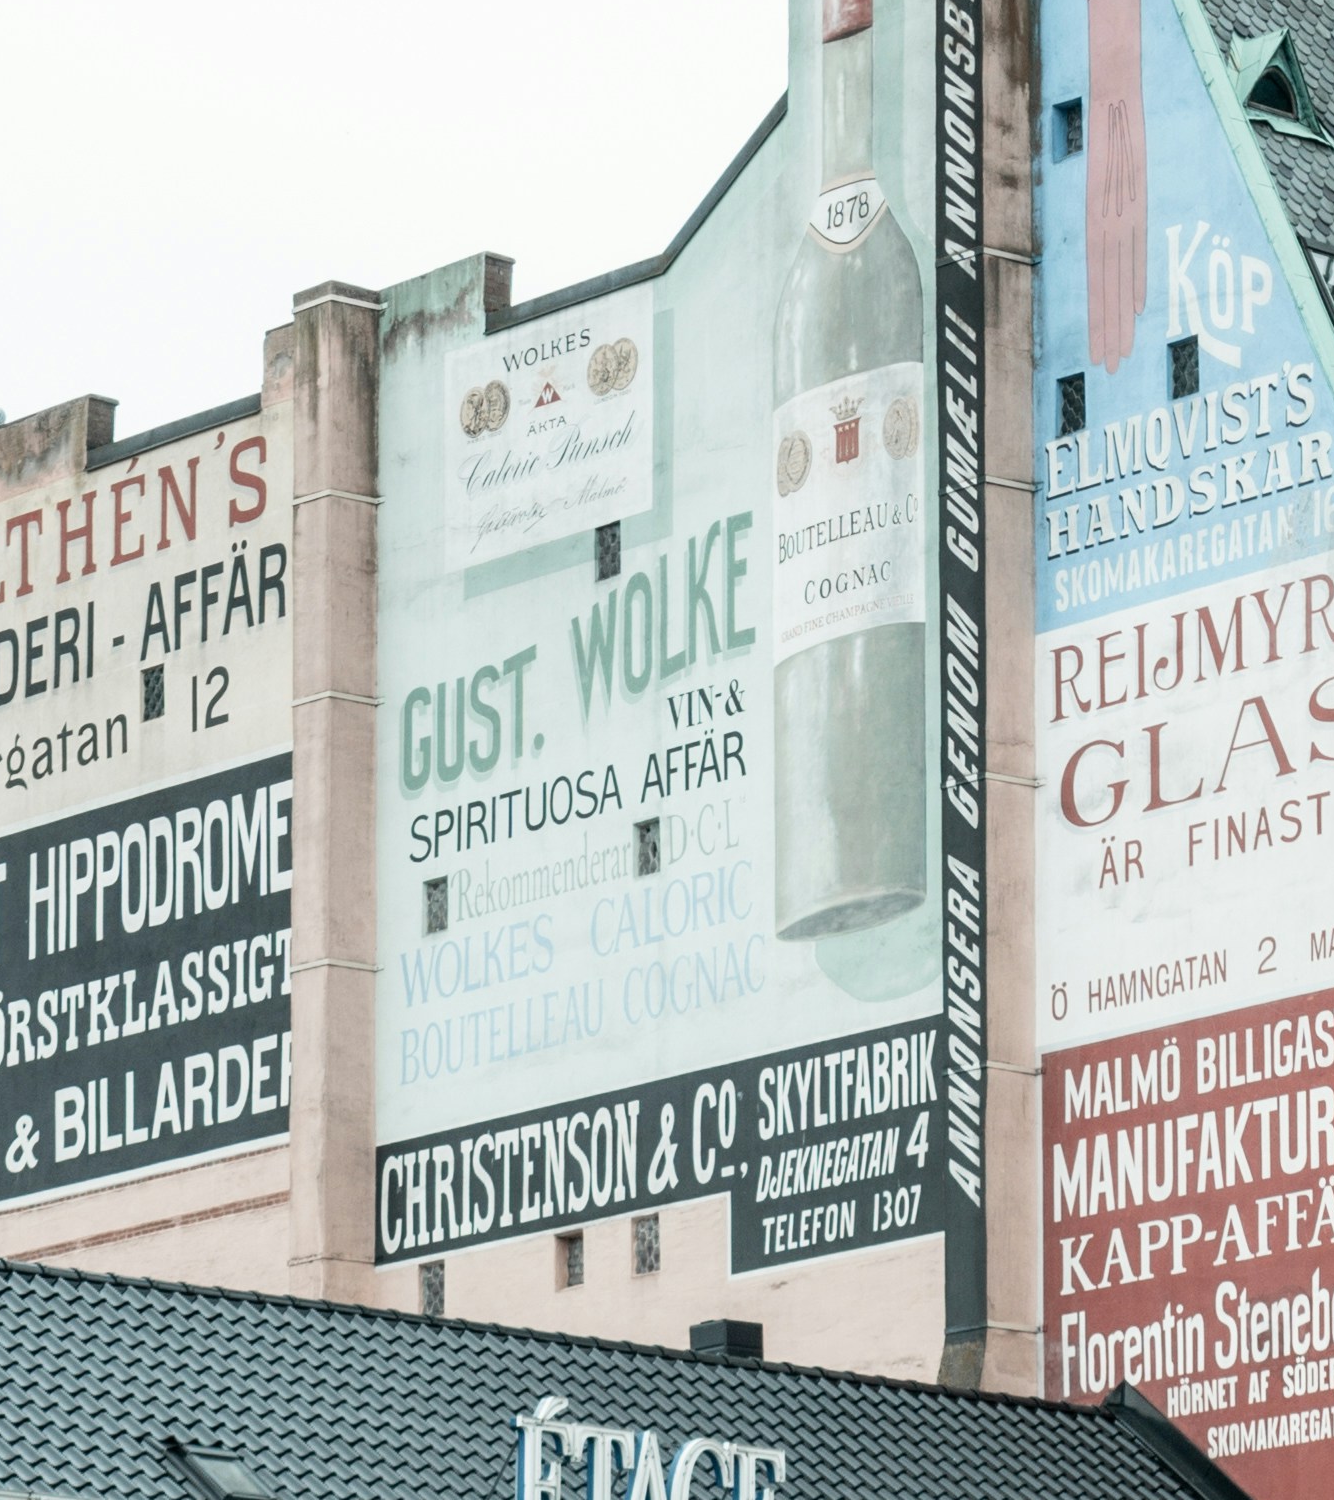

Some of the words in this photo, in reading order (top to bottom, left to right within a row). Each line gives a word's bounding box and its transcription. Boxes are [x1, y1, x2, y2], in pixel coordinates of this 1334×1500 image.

[825, 190, 870, 231] 1878
[1164, 219, 1274, 368] KÖP
[502, 328, 591, 373] WOLKES
[527, 414, 567, 436] ÄKTA
[1045, 360, 1316, 501] ELMQVIST'S
[778, 501, 889, 565] BOUTELLEAU
[892, 504, 903, 525] &
[1045, 430, 1334, 561] HANDSKAR
[141, 540, 287, 662] AFFÄR
[804, 560, 892, 604] COGNAC
[1055, 503, 1297, 613] SKOMAKAREGATAN
[190, 665, 232, 735] 12
[401, 643, 546, 796] GUST.
[569, 510, 757, 726] WOLKE
[945, 592, 980, 830] GENOM
[409, 764, 623, 863] SPIRITUOSA
[641, 729, 747, 803] AFFÄR
[1098, 835, 1145, 891] ÄR
[1187, 789, 1333, 868] FINAST
[28, 779, 293, 960] HIPPODROME
[450, 831, 632, 923] Rekommenderar
[400, 913, 555, 1009] WOLKES
[590, 860, 754, 958] CALORIC
[1051, 982, 1068, 1022] Ö
[1088, 949, 1228, 1015] HAMNGATAN
[1257, 936, 1278, 975] 2
[400, 976, 605, 1087] BOUTELLEAU
[622, 933, 767, 1027] COGNAC
[946, 855, 983, 1207] ANNONSERA
[758, 1029, 938, 1141] SKYLTFABRIK
[1064, 1038, 1182, 1126] MALMÖ
[5, 1114, 40, 1174] &
[380, 1099, 641, 1255] CHRISTENSON
[646, 1103, 681, 1195] &
[755, 1126, 900, 1203] DJEKNEGATAN
[905, 1111, 930, 1170] 4
[761, 1200, 857, 1256] TELEFON
[872, 1184, 922, 1233] 1307
[1060, 1303, 1205, 1398] Florentin
[1166, 1374, 1238, 1420] HÖRNET
[1247, 1372, 1269, 1405] AF
